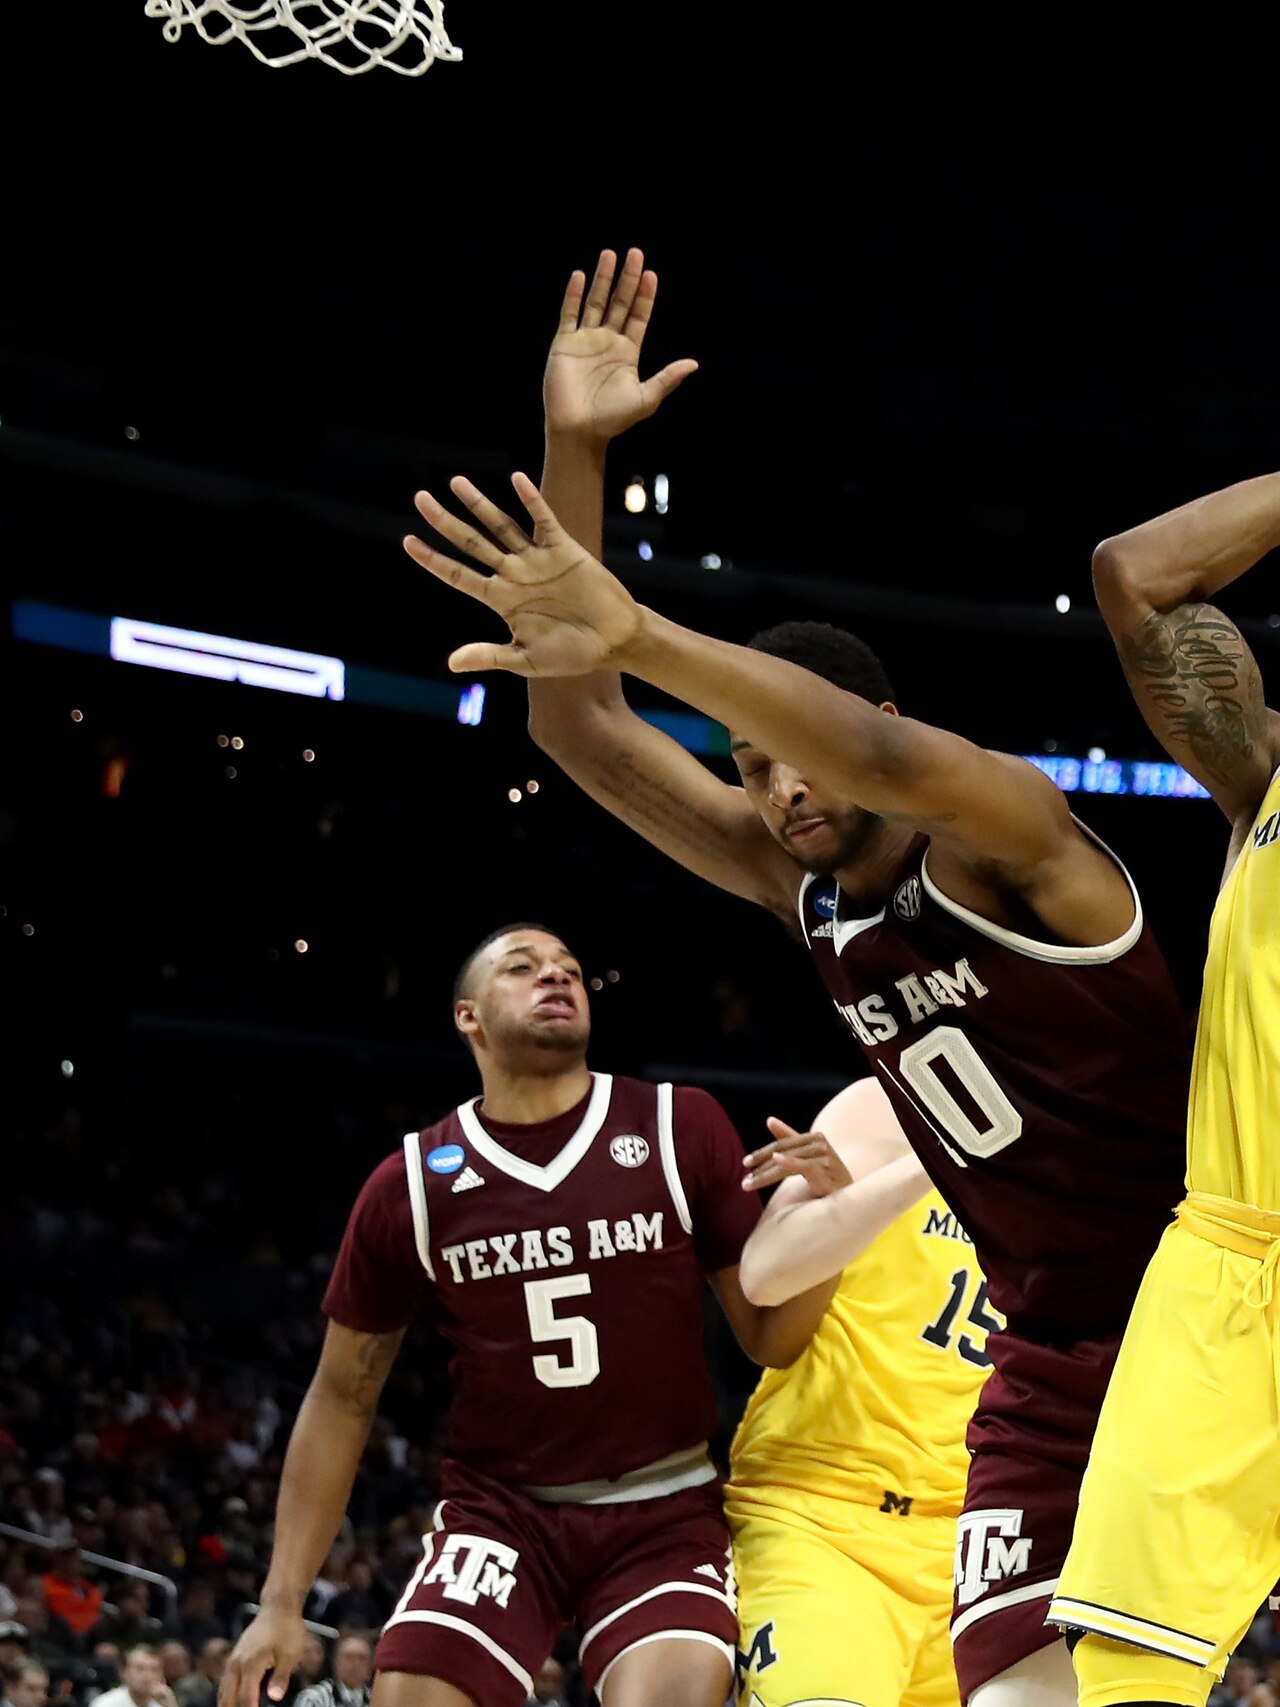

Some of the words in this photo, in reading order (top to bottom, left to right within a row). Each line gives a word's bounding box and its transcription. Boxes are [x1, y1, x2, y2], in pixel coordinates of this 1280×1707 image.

[894, 957, 990, 1024] A&M
[611, 1136, 649, 1167] SEC
[440, 1225, 575, 1284] TEXAS
[587, 1211, 664, 1260] A&M
[523, 1272, 600, 1389] 5
[921, 1268, 1008, 1367] 15
[880, 1490, 914, 1516] M
